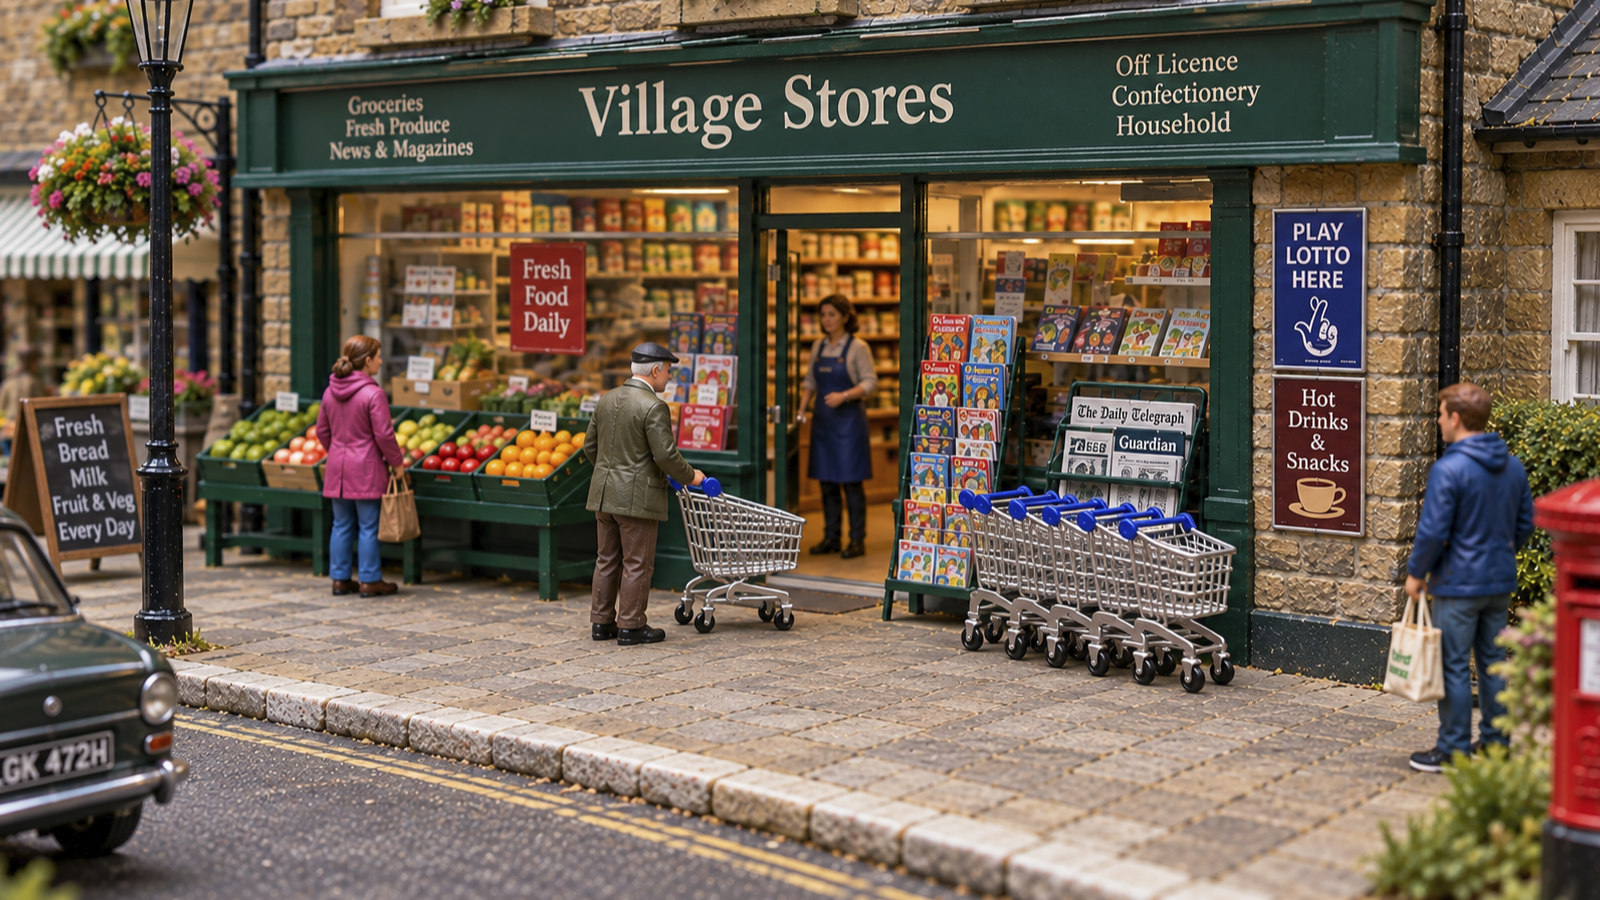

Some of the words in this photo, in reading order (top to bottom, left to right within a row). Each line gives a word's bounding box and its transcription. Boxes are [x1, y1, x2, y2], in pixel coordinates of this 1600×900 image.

[1117, 54, 1150, 76] Off
[1157, 53, 1237, 74] Licence
[348, 94, 423, 115] Groceries
[1113, 82, 1260, 106] Confectionery
[579, 81, 761, 149] Village
[784, 75, 953, 129] Stores
[1117, 111, 1231, 135] Household
[346, 118, 384, 137] Fresh
[390, 116, 450, 134] Produce
[330, 142, 370, 159] News
[375, 141, 387, 158] &
[394, 138, 473, 162] Magazines
[1294, 223, 1343, 240] PLAY
[1287, 247, 1350, 264] LOTTO
[523, 258, 571, 279] Fresh
[1293, 271, 1343, 288] HERE
[526, 286, 568, 306] Food
[524, 312, 570, 338] Daily
[1302, 389, 1335, 407] Hot
[54, 413, 104, 438] Fresh
[1077, 404, 1098, 418] The
[1100, 406, 1128, 424] Daily
[1131, 407, 1185, 426] Telegraph
[1289, 411, 1348, 430] Drinks
[58, 439, 109, 463] Bread
[1119, 435, 1177, 453] Guardian
[1311, 434, 1325, 450] &
[1287, 452, 1349, 472] Snacks
[70, 465, 108, 488] Milk
[52, 494, 90, 516] Fruit
[92, 493, 105, 511] &
[105, 491, 136, 513] Veg
[58, 521, 102, 543] Every
[105, 517, 135, 540] Day
[0, 752, 40, 787] GK
[44, 739, 107, 775] 472H
